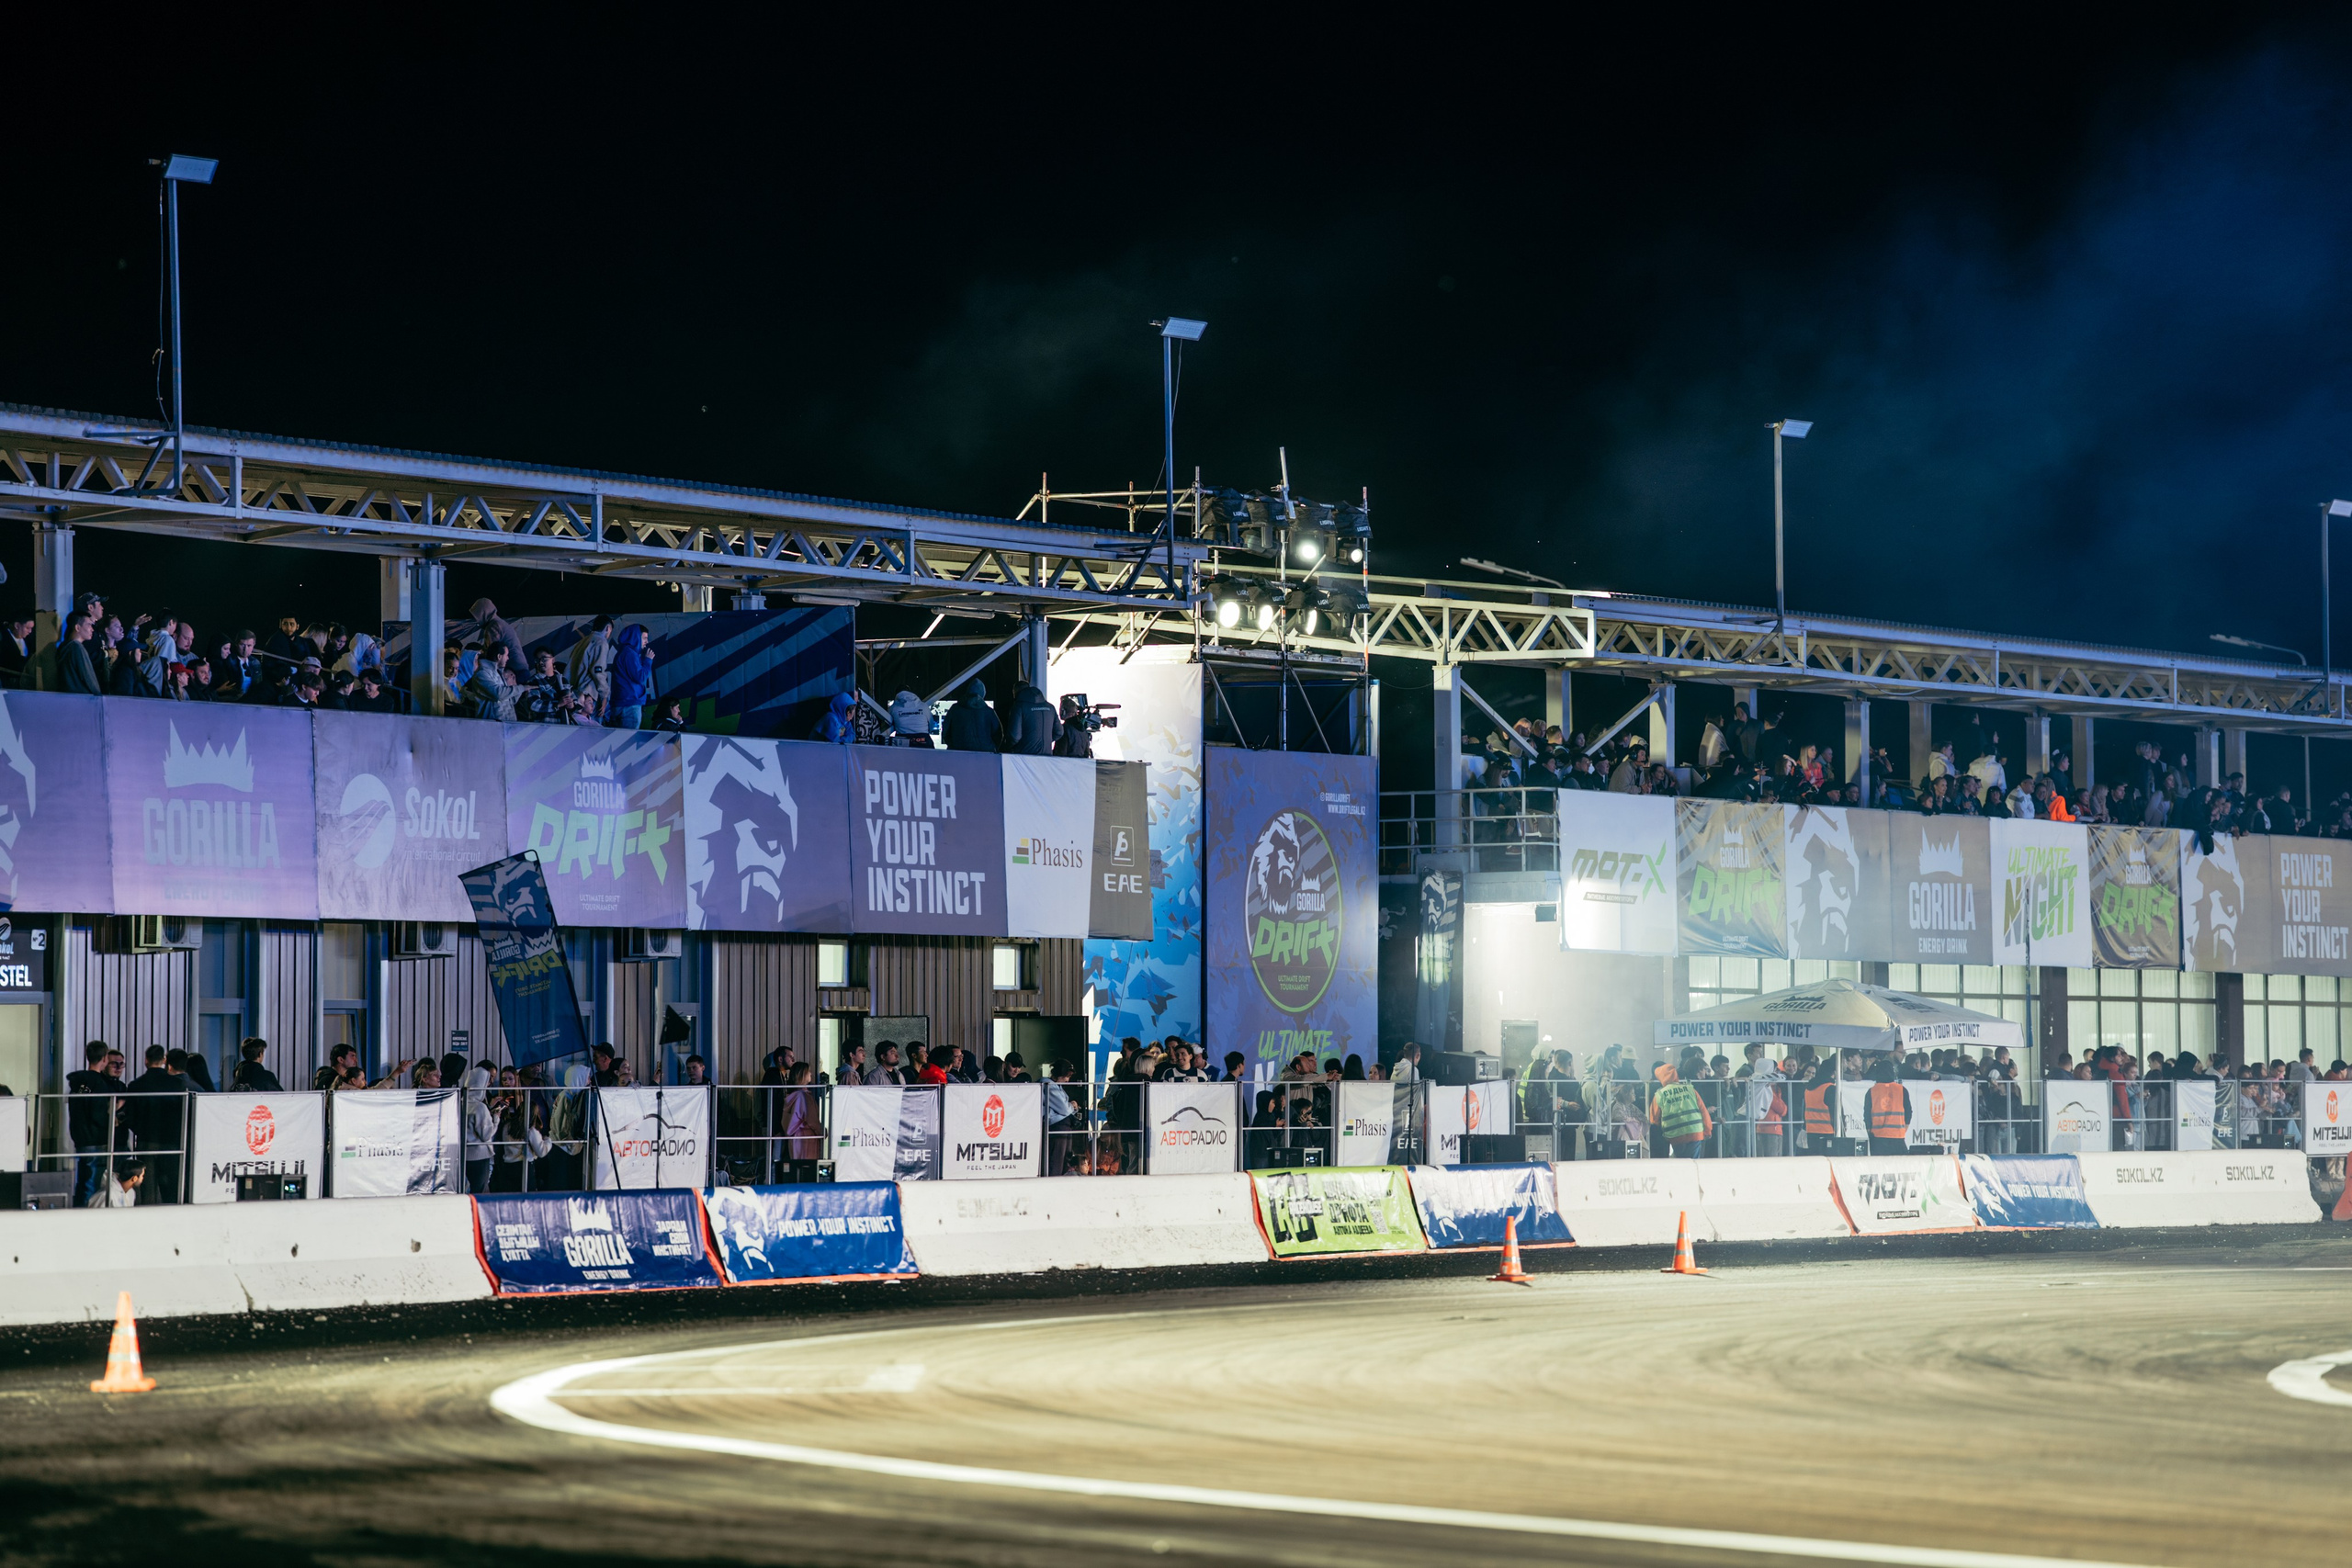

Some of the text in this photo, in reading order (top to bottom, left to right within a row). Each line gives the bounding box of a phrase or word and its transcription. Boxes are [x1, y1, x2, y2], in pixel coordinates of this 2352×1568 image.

[574, 782, 625, 809] GORILLA
[865, 769, 957, 818] POWER
[142, 797, 280, 869] GORILLA
[865, 818, 936, 865] YOUR
[526, 802, 671, 886] DRIFT
[1031, 838, 1083, 868] Phasis
[456, 851, 481, 863] circuit
[1719, 846, 1750, 868] GORILLA
[2007, 846, 2070, 876] ULTIMATE
[2125, 864, 2151, 885] GORILLA
[2280, 852, 2333, 888] POWER
[867, 866, 986, 915] INSTINCT
[1103, 873, 1143, 894] EAE
[1689, 860, 1781, 926] DRIFT
[1296, 892, 1326, 911] GORILLA
[1908, 881, 1976, 931] GORILLA
[2004, 864, 2077, 948] NIGHT
[2098, 881, 2176, 938] DRIFT
[2281, 888, 2322, 923] YOUR
[1252, 916, 1335, 971] DRIFT
[1918, 937, 1968, 954] ENERGY DRINK
[2282, 925, 2349, 960] INSTINCT
[1280, 983, 1309, 991] TOURNAMENT
[1762, 1001, 1827, 1010] GORILLA
[1670, 1021, 1812, 1039] POWER YOUR INSTINCT
[1909, 1022, 1980, 1043] POWER YOUR INSTINCT
[1258, 1030, 1333, 1063] ULTIMATE
[852, 1127, 891, 1147] Phasis
[1355, 1118, 1386, 1136] Phasis
[1912, 1129, 1962, 1144] MITSUJI
[2313, 1126, 2352, 1141] MITSUJI
[956, 1142, 1027, 1161] MITSUJI
[2116, 1168, 2165, 1183] SOKOL.KZ
[2226, 1166, 2275, 1181] SOKOL.KZ
[1599, 1177, 1657, 1196] SOKOL.KZ
[2007, 1183, 2080, 1200] POWER YOUR INSTINCT
[779, 1215, 896, 1238] POWER YOUR INSTINCT
[1333, 1225, 1353, 1235] АНТОНА
[563, 1234, 635, 1268] GORILLA
[652, 1244, 692, 1257] ИНСТИНКТ
[582, 1269, 632, 1280] ENERGY DRINK
